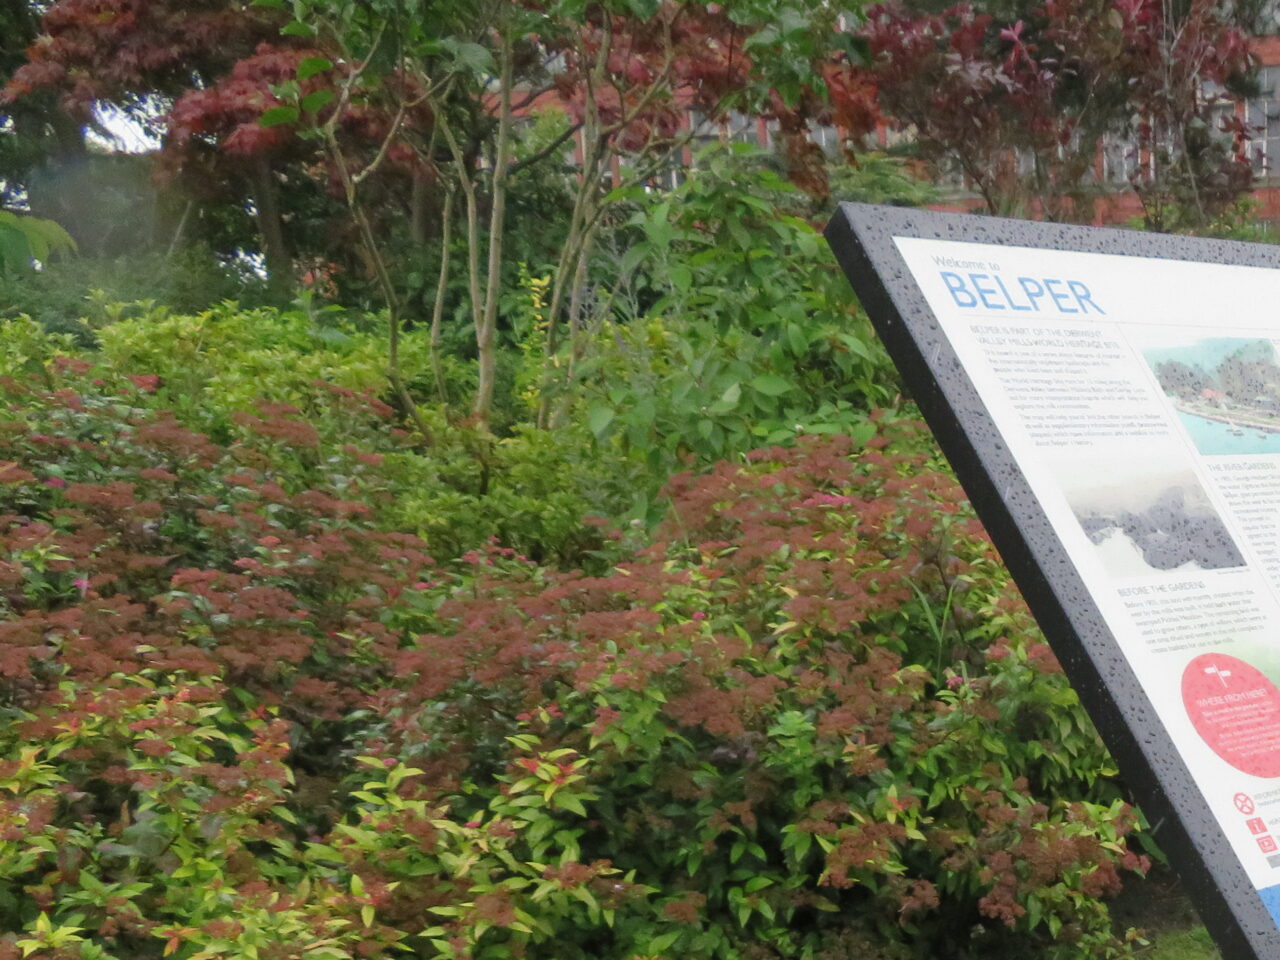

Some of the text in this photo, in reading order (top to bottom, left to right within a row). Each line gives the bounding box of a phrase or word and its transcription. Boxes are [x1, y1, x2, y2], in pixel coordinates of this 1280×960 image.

[931, 254, 1001, 271] Welcome to
[939, 271, 1107, 316] BELPER
[970, 325, 997, 334] BELPER
[1010, 327, 1030, 335] PART
[1032, 328, 1044, 336] OF
[1046, 328, 1064, 336] THE
[976, 336, 1007, 345] VALLEY
[1008, 337, 1032, 346] MILLS
[1033, 338, 1063, 347] WORLD
[1064, 339, 1102, 348] HERITAGE
[1208, 463, 1223, 471] THE
[1244, 461, 1275, 470] GARDENS
[1117, 581, 1205, 596] BEFORE THE GARDENS
[1224, 692, 1245, 702] FROM
